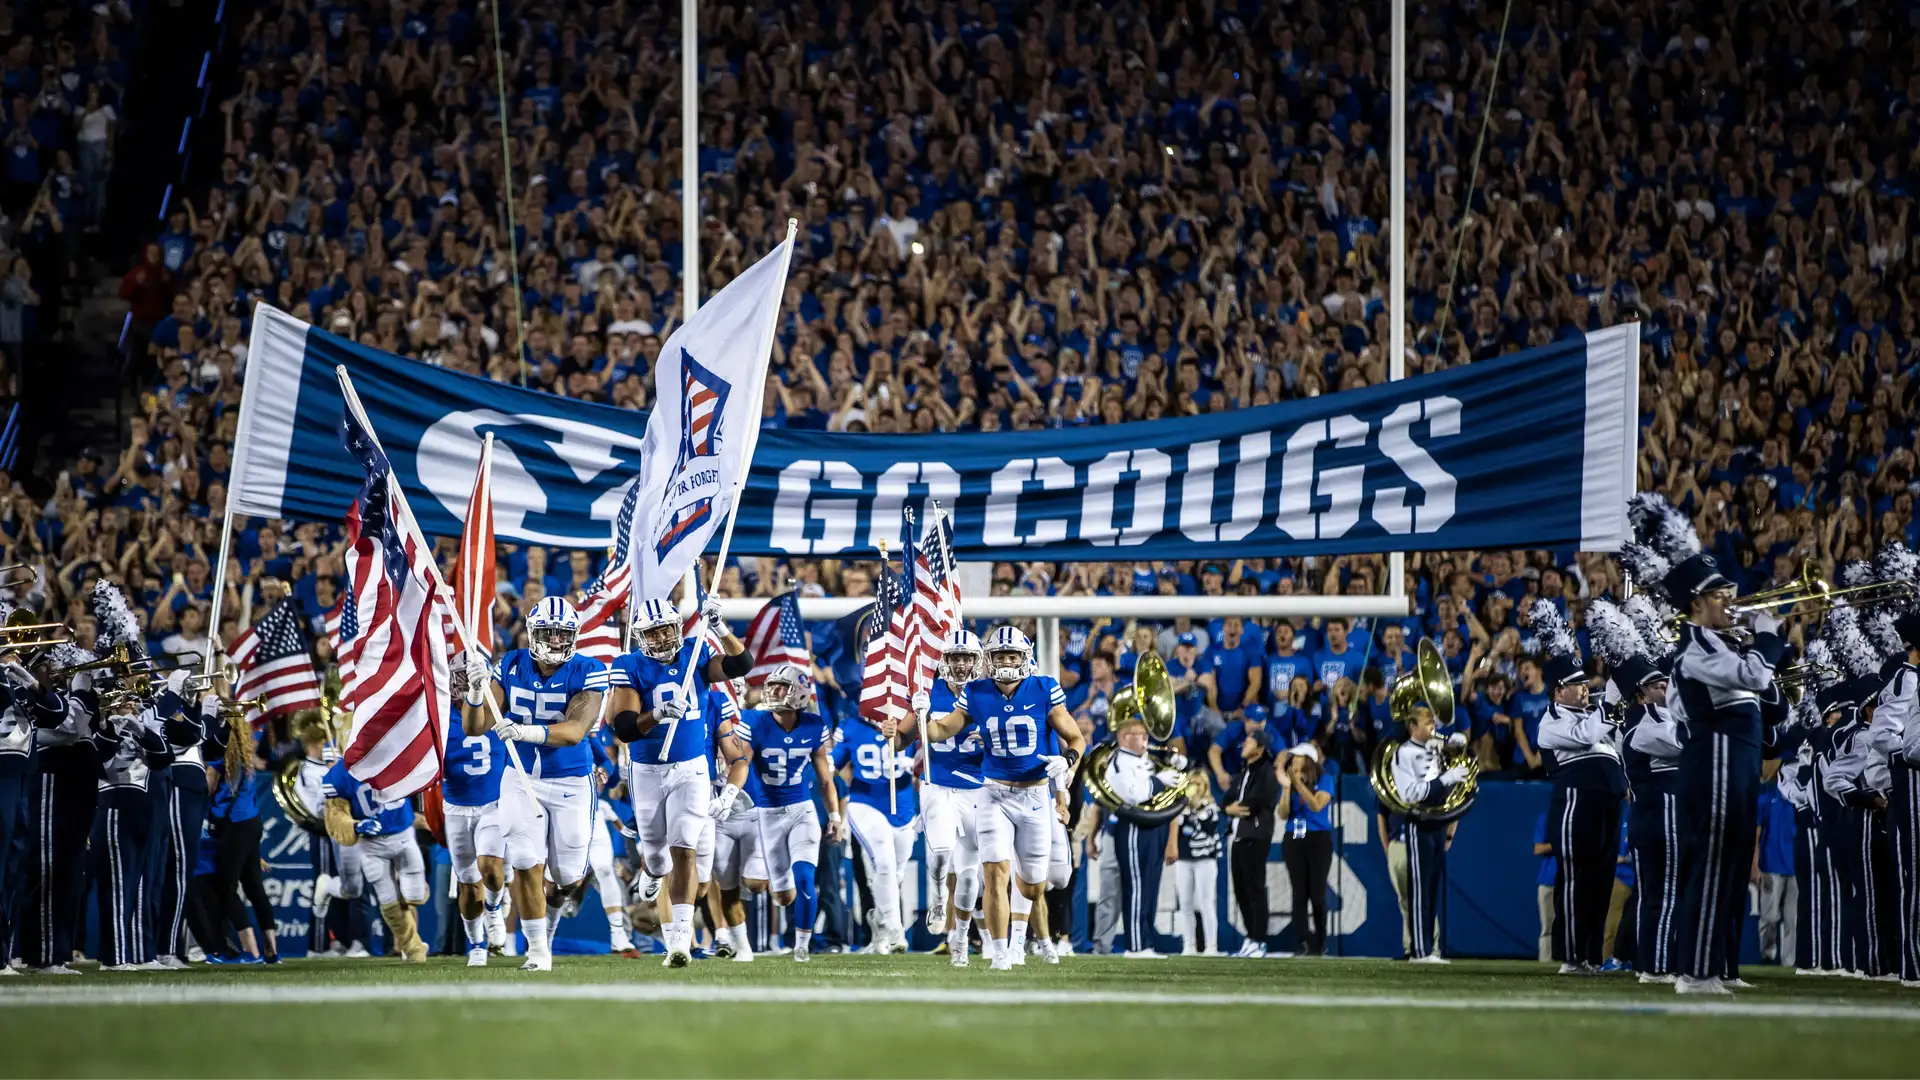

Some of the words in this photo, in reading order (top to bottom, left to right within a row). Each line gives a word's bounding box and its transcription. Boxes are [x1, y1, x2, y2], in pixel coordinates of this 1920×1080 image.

[769, 459, 961, 554] GO
[983, 396, 1463, 547] COUGS
[509, 664, 517, 676] A
[510, 685, 567, 725] 55
[462, 734, 491, 776] 3
[986, 714, 1037, 757] 10
[761, 747, 813, 786] 37
[856, 743, 906, 780] 98
